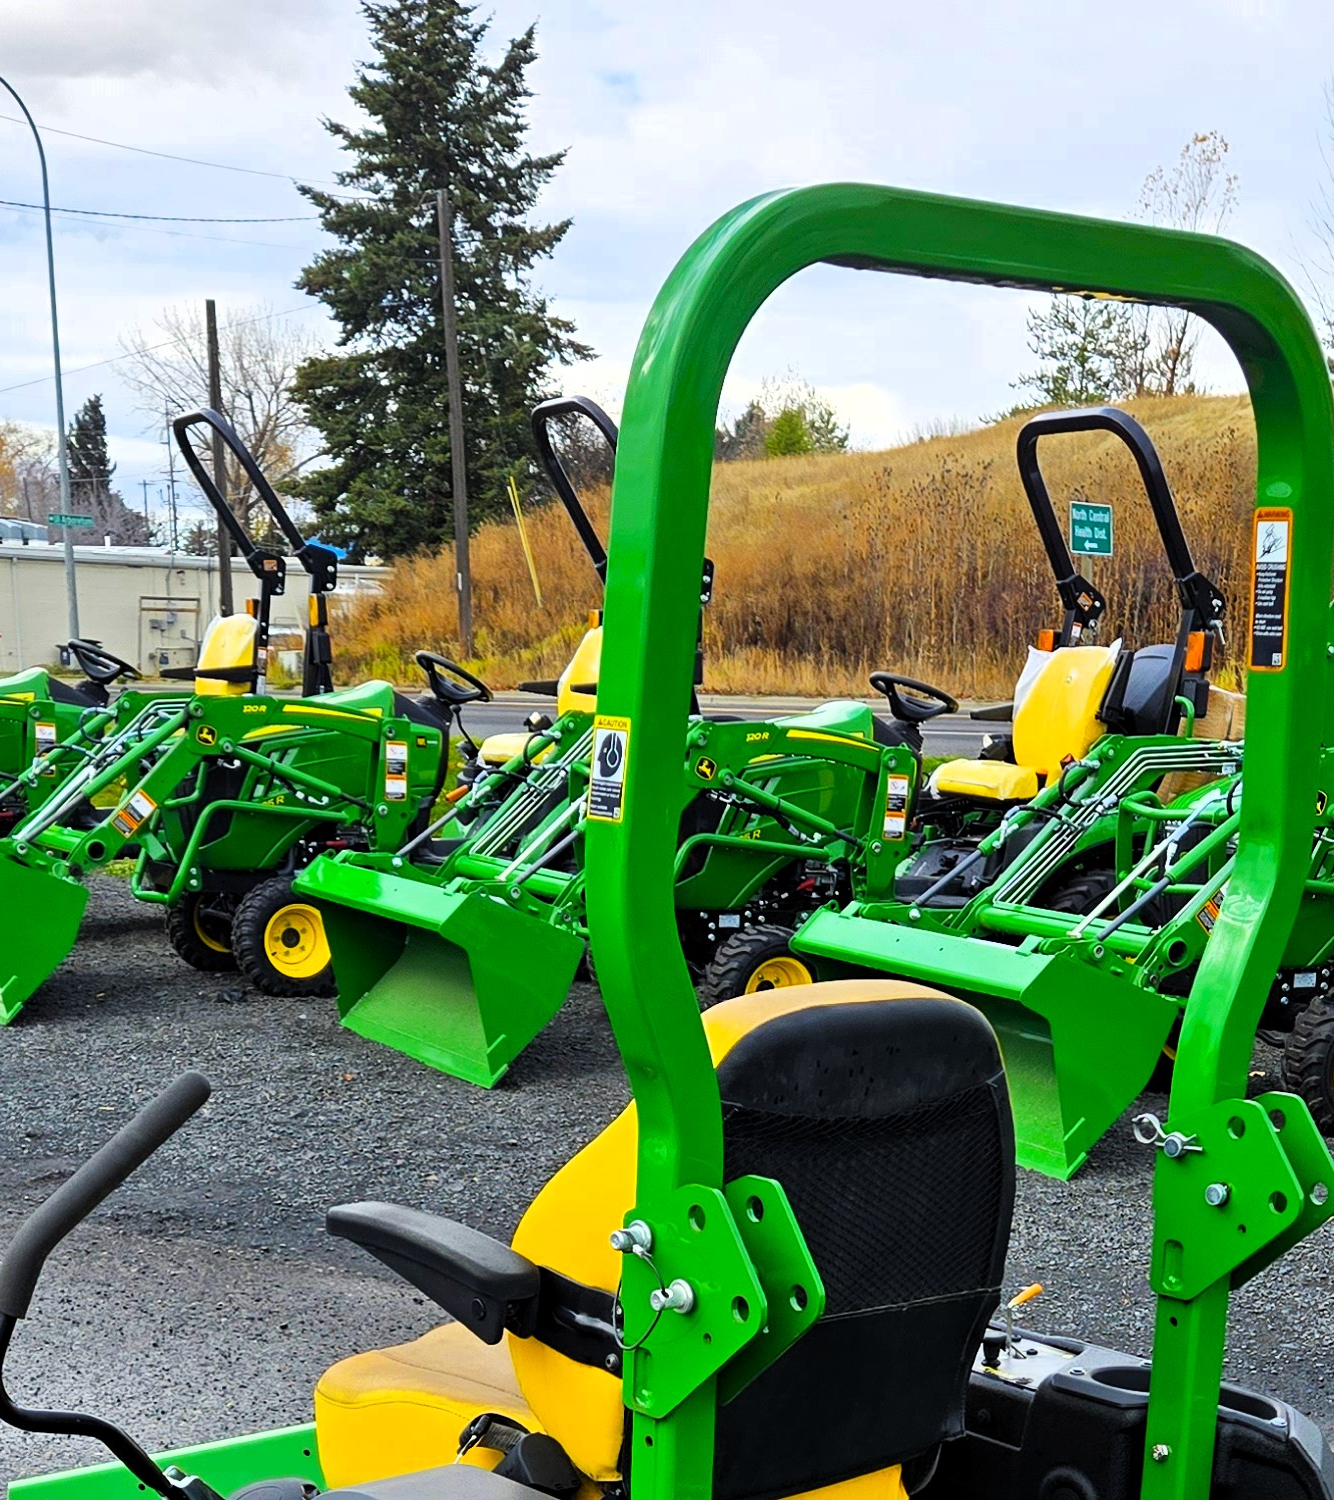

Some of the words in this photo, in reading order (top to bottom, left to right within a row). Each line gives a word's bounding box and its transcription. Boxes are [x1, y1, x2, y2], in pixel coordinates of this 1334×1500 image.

[1072, 508, 1087, 521] North
[1089, 509, 1109, 523] Central
[1074, 525, 1092, 538] Health
[602, 719, 628, 729] CAUTION
